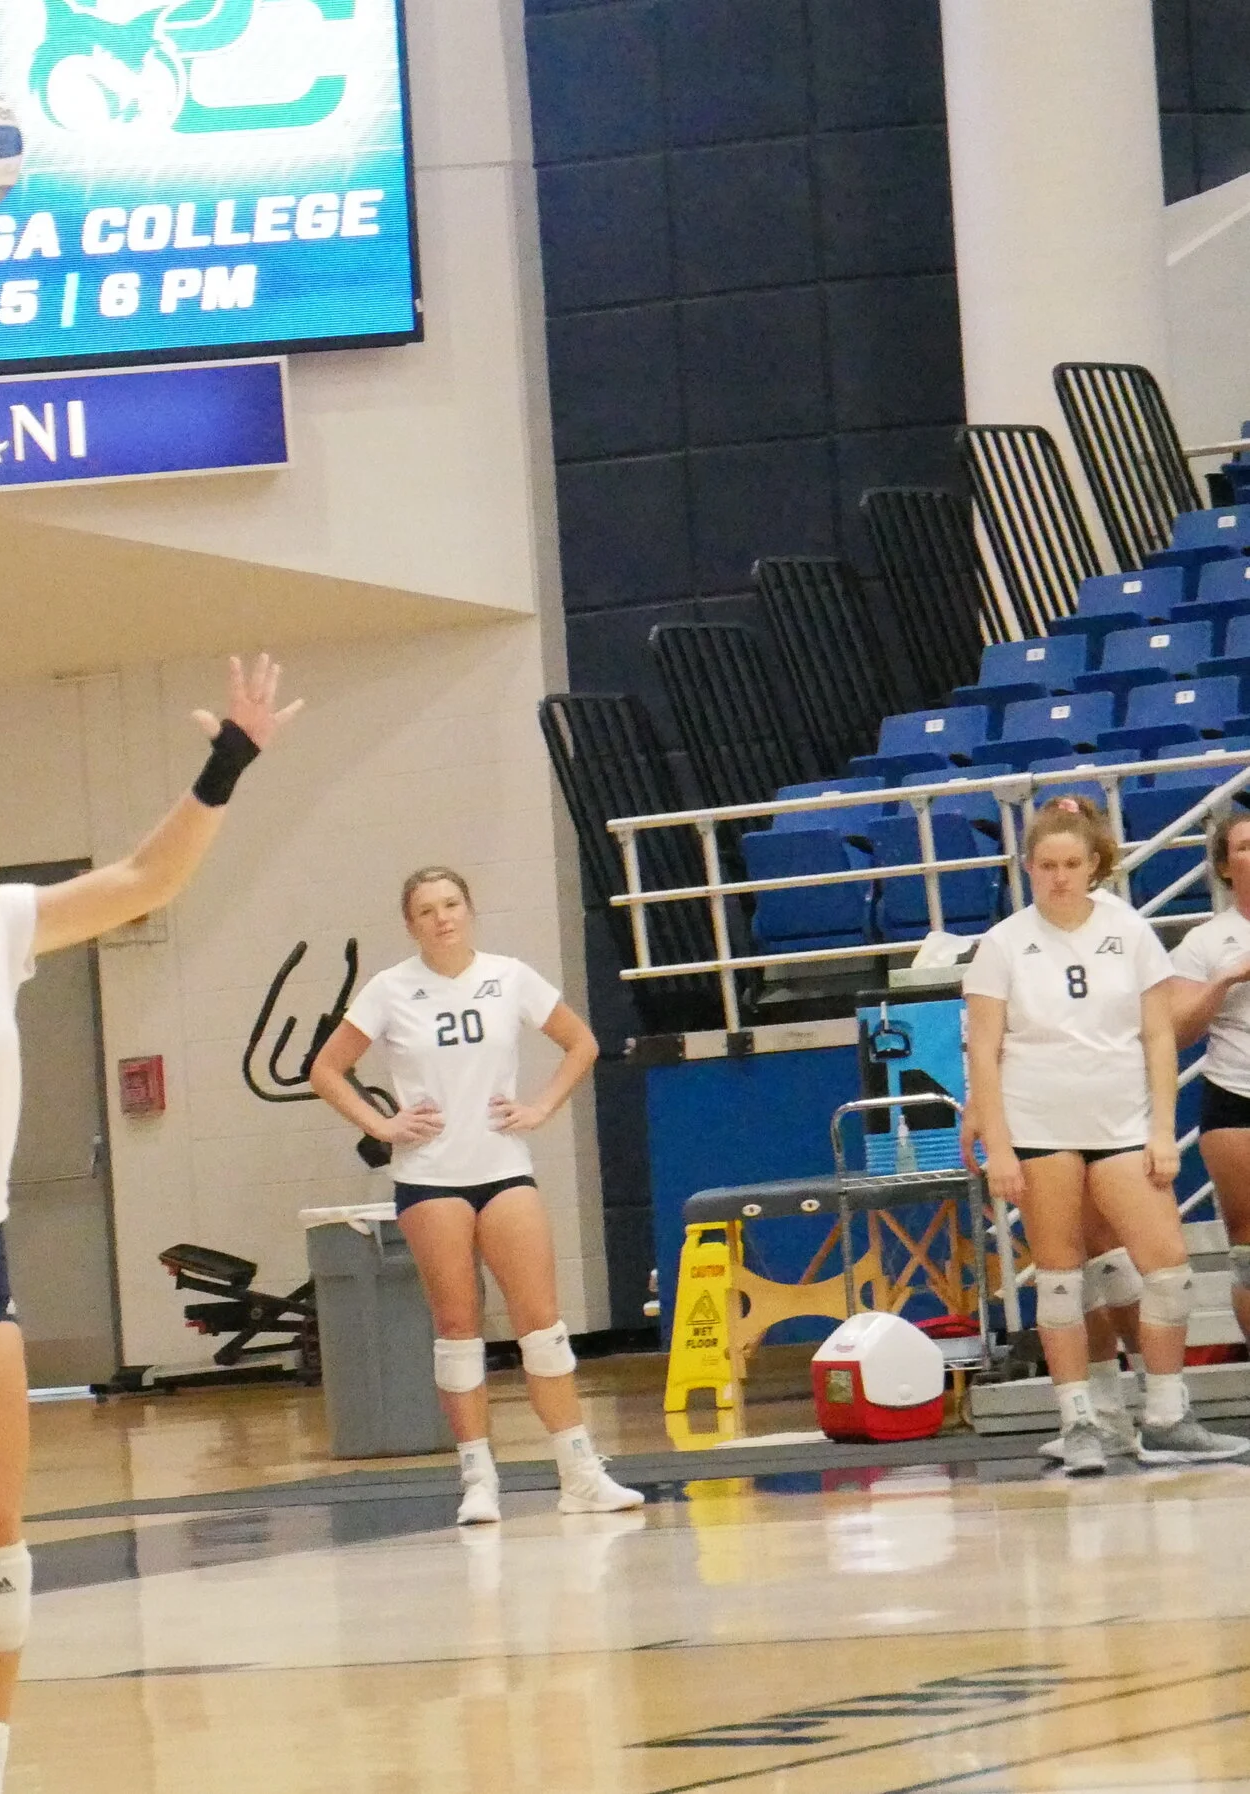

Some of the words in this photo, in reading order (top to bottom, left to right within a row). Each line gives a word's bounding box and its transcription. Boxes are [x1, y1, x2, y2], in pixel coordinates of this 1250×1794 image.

[81, 188, 385, 255] COLLEGE
[98, 271, 141, 319] 6
[159, 264, 259, 315] PM
[1065, 964, 1088, 999] 8
[435, 1008, 485, 1047] 20
[685, 1338, 719, 1350] FLOOR
[692, 1326, 713, 1337] WET
